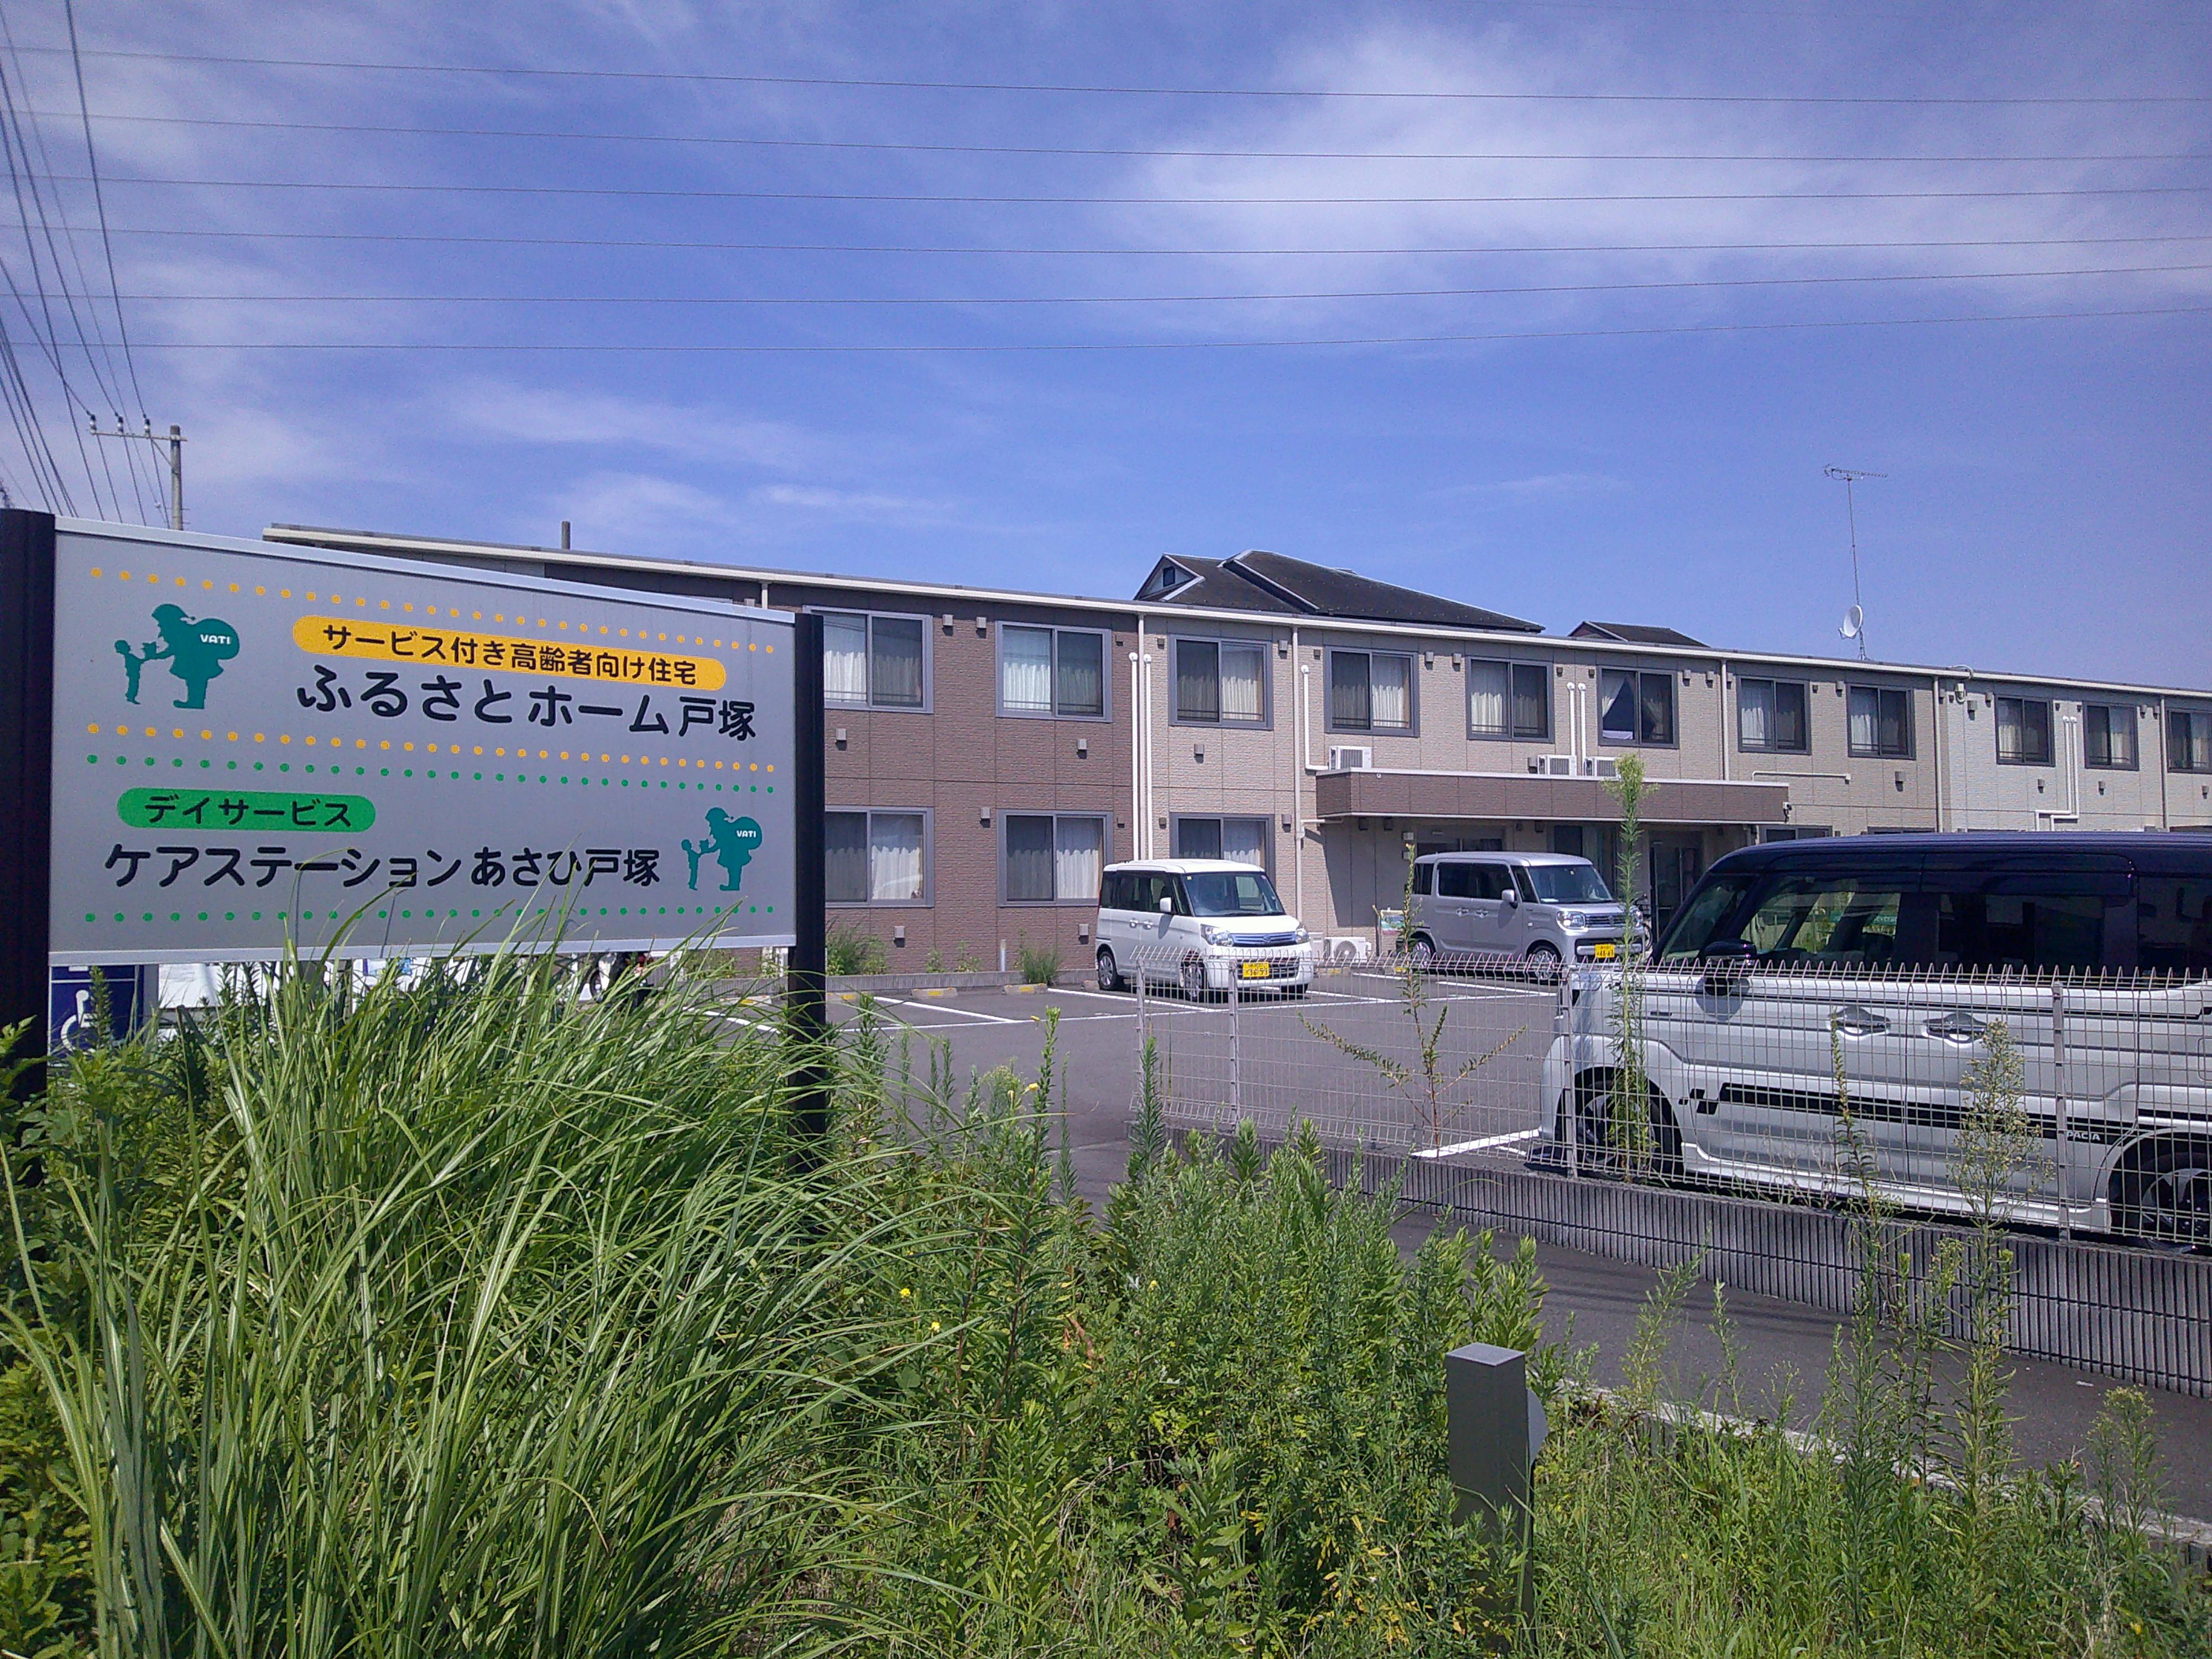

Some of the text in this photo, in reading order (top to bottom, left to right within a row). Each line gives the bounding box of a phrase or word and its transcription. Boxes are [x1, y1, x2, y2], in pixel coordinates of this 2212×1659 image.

[200, 634, 231, 645] VATI
[323, 624, 696, 685] サービス付き高齢者向け住宅
[297, 664, 757, 740] ふるさとホーム戸塚
[144, 794, 351, 827] デイサービス
[105, 844, 660, 887] ケアステーションあさひ戸塚
[2067, 1130, 2101, 1141] PACIA
